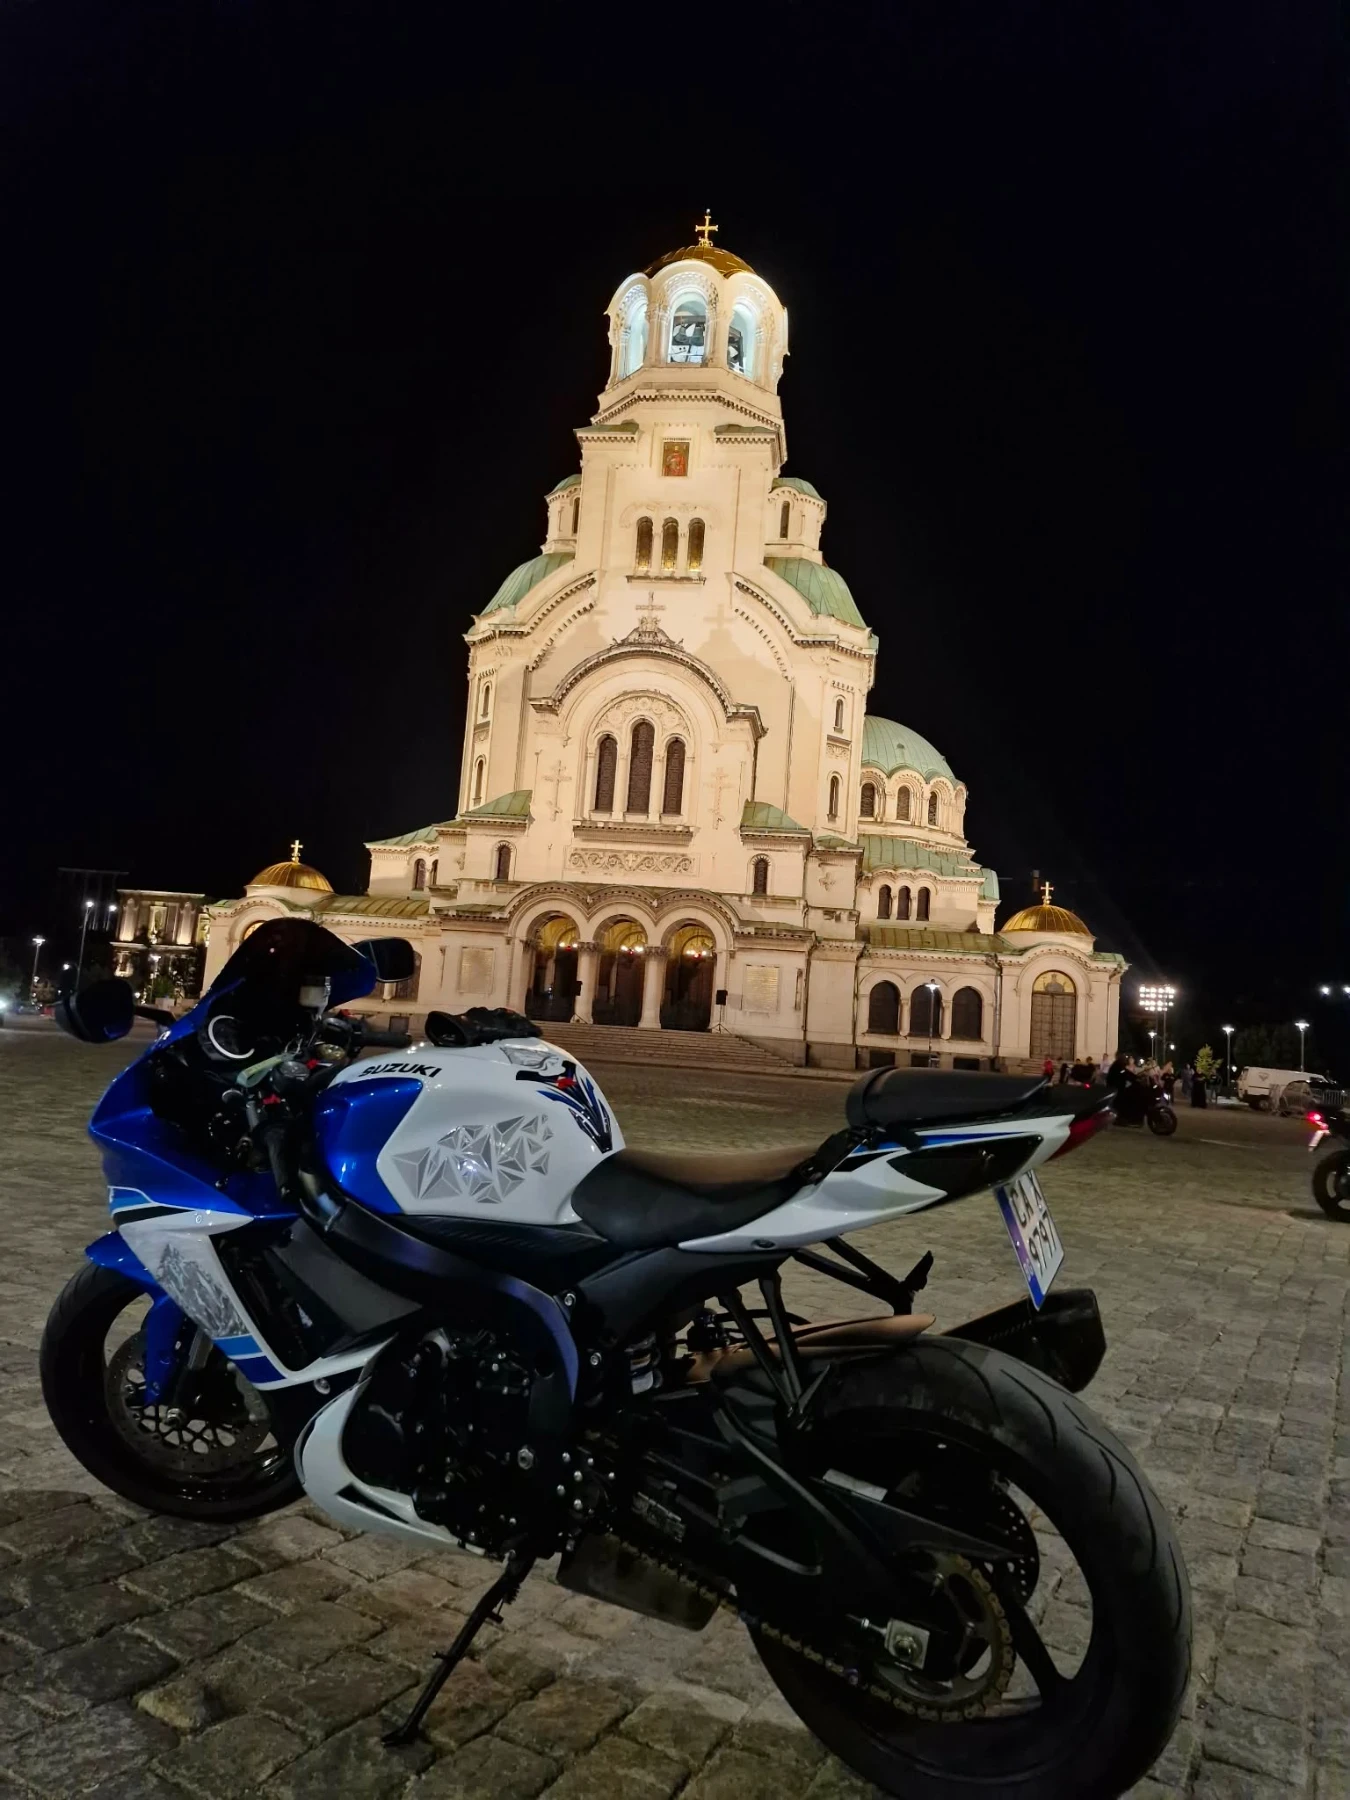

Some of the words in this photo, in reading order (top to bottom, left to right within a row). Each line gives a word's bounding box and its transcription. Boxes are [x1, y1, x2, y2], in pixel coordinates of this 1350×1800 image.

[358, 1063, 442, 1078] SUZUKI
[1009, 1180, 1034, 1228] CA
[1028, 1211, 1057, 1278] 9797
